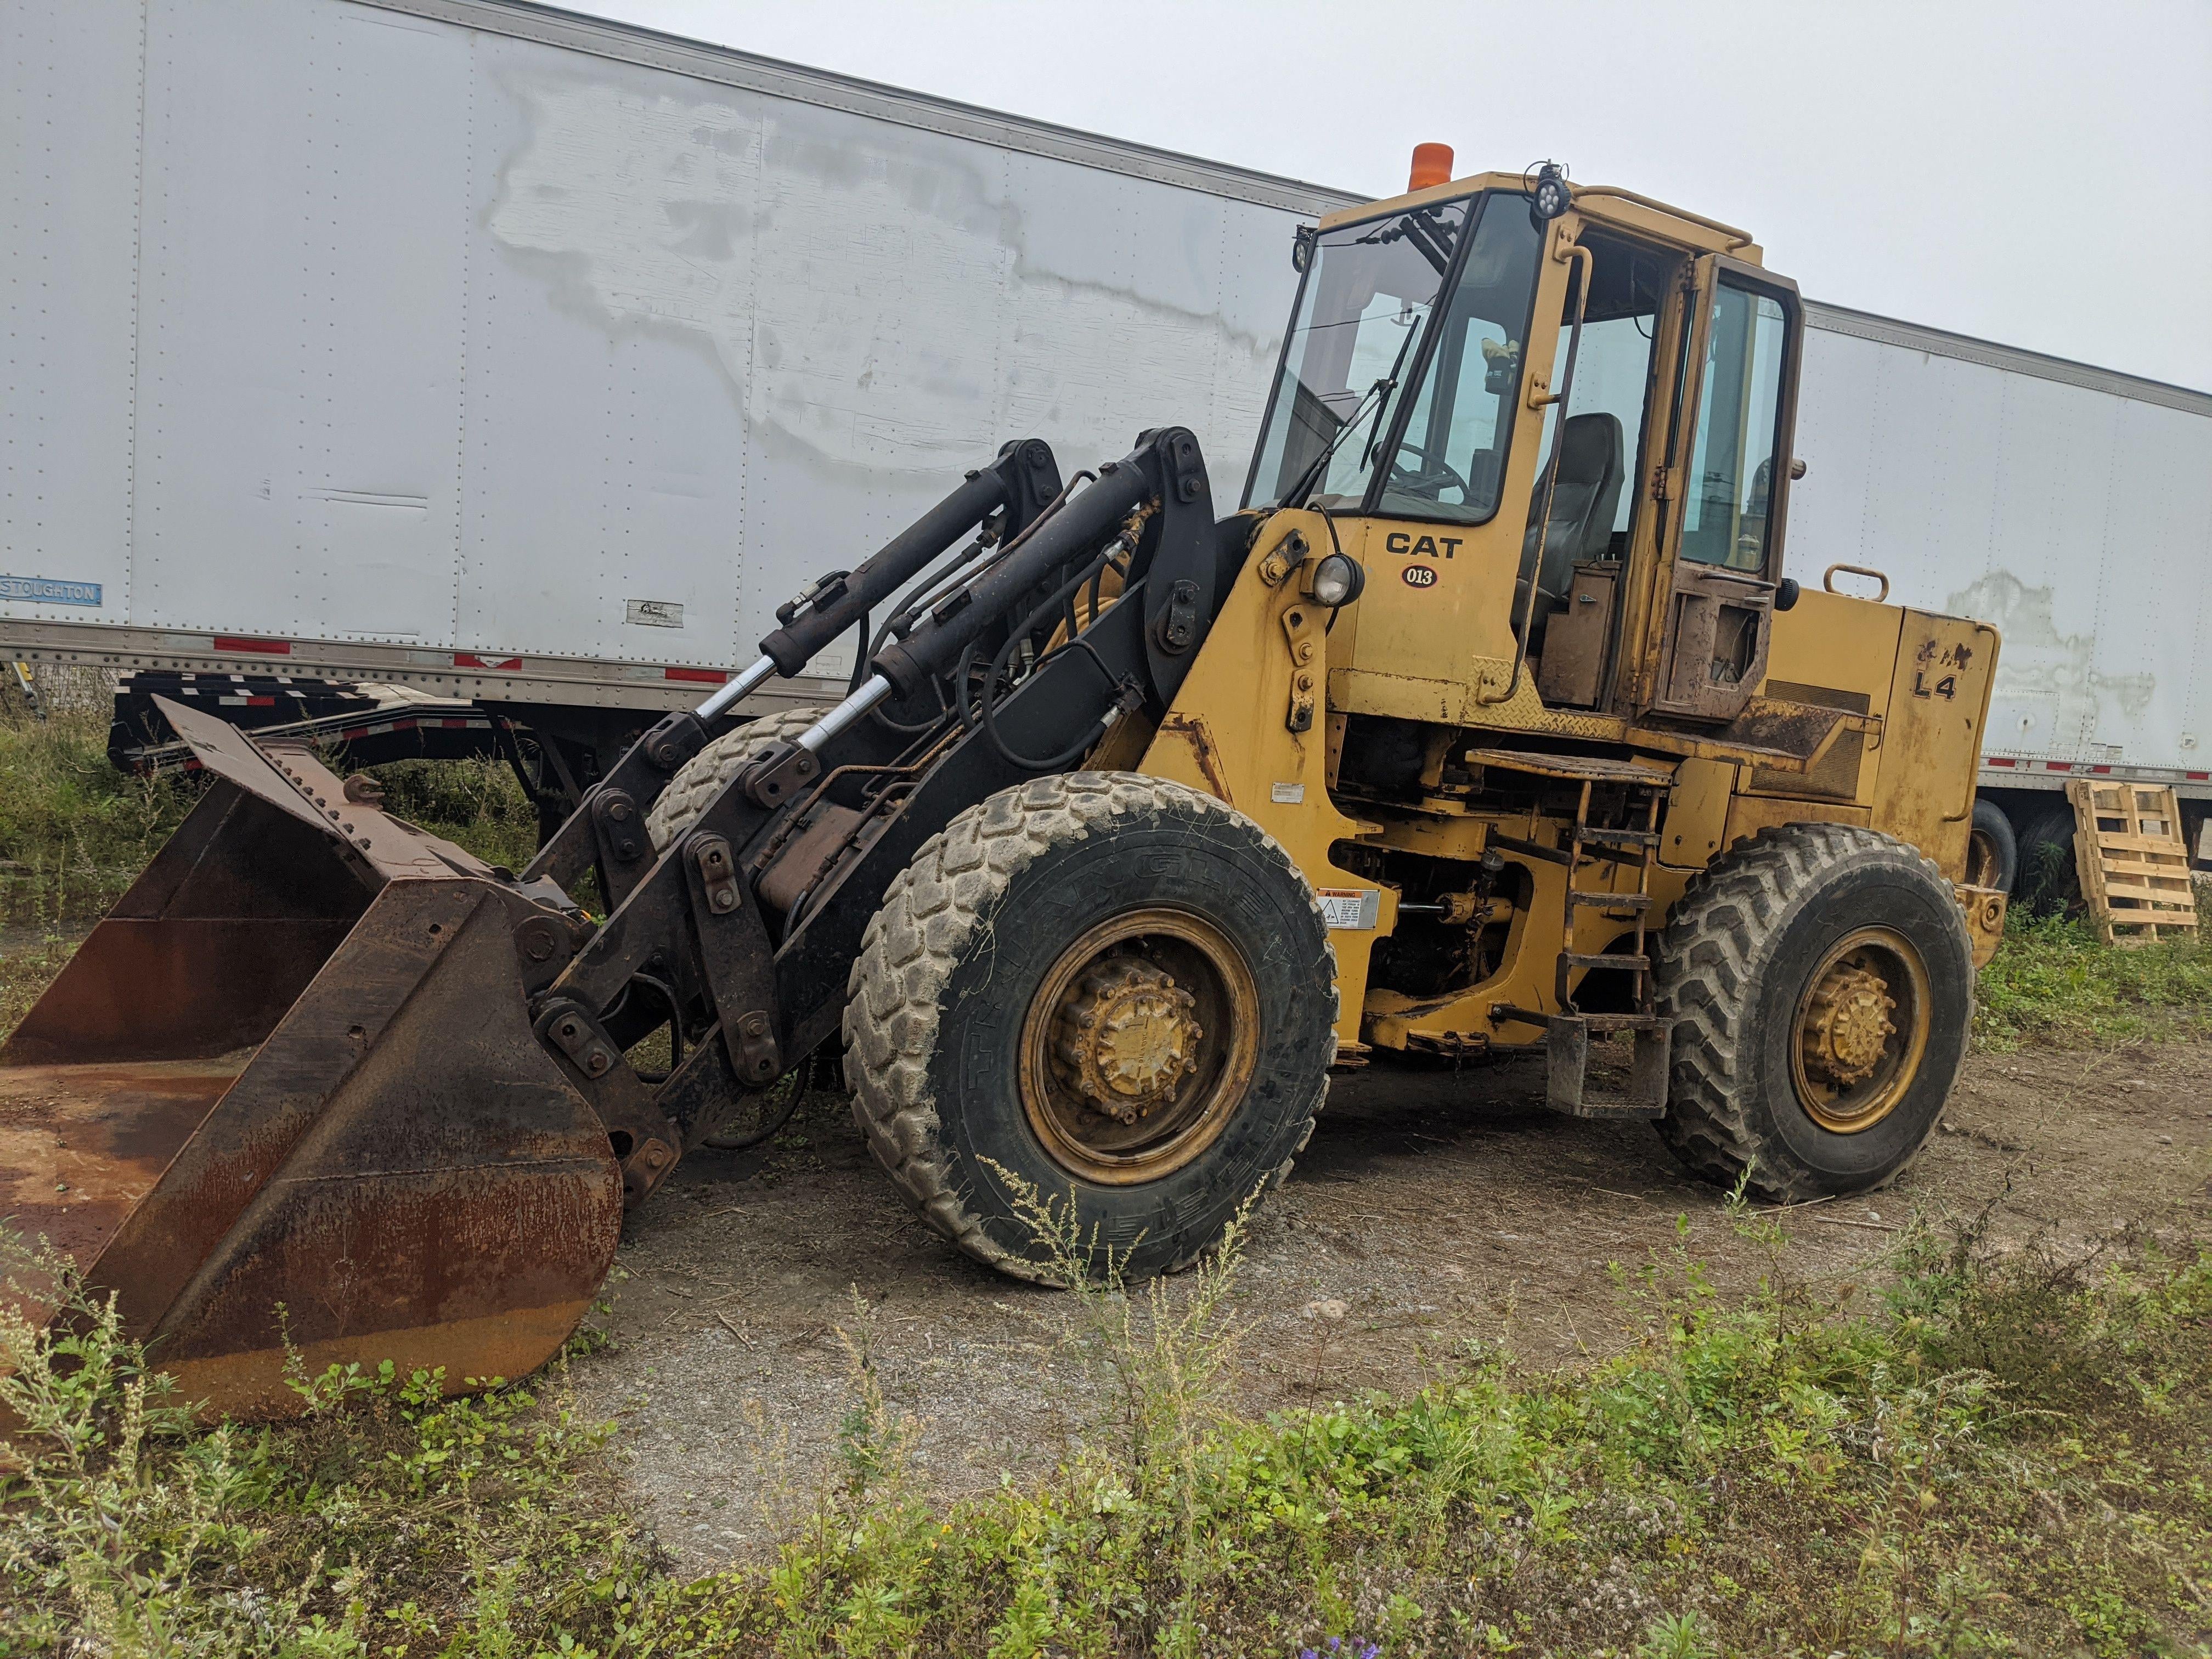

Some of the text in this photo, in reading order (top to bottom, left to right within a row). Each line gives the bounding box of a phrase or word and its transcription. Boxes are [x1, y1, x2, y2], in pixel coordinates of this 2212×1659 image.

[1386, 532, 1463, 559] CAT
[1407, 568, 1432, 585] 013
[0, 580, 95, 601] STOUGHTON
[1913, 669, 1956, 702] L4
